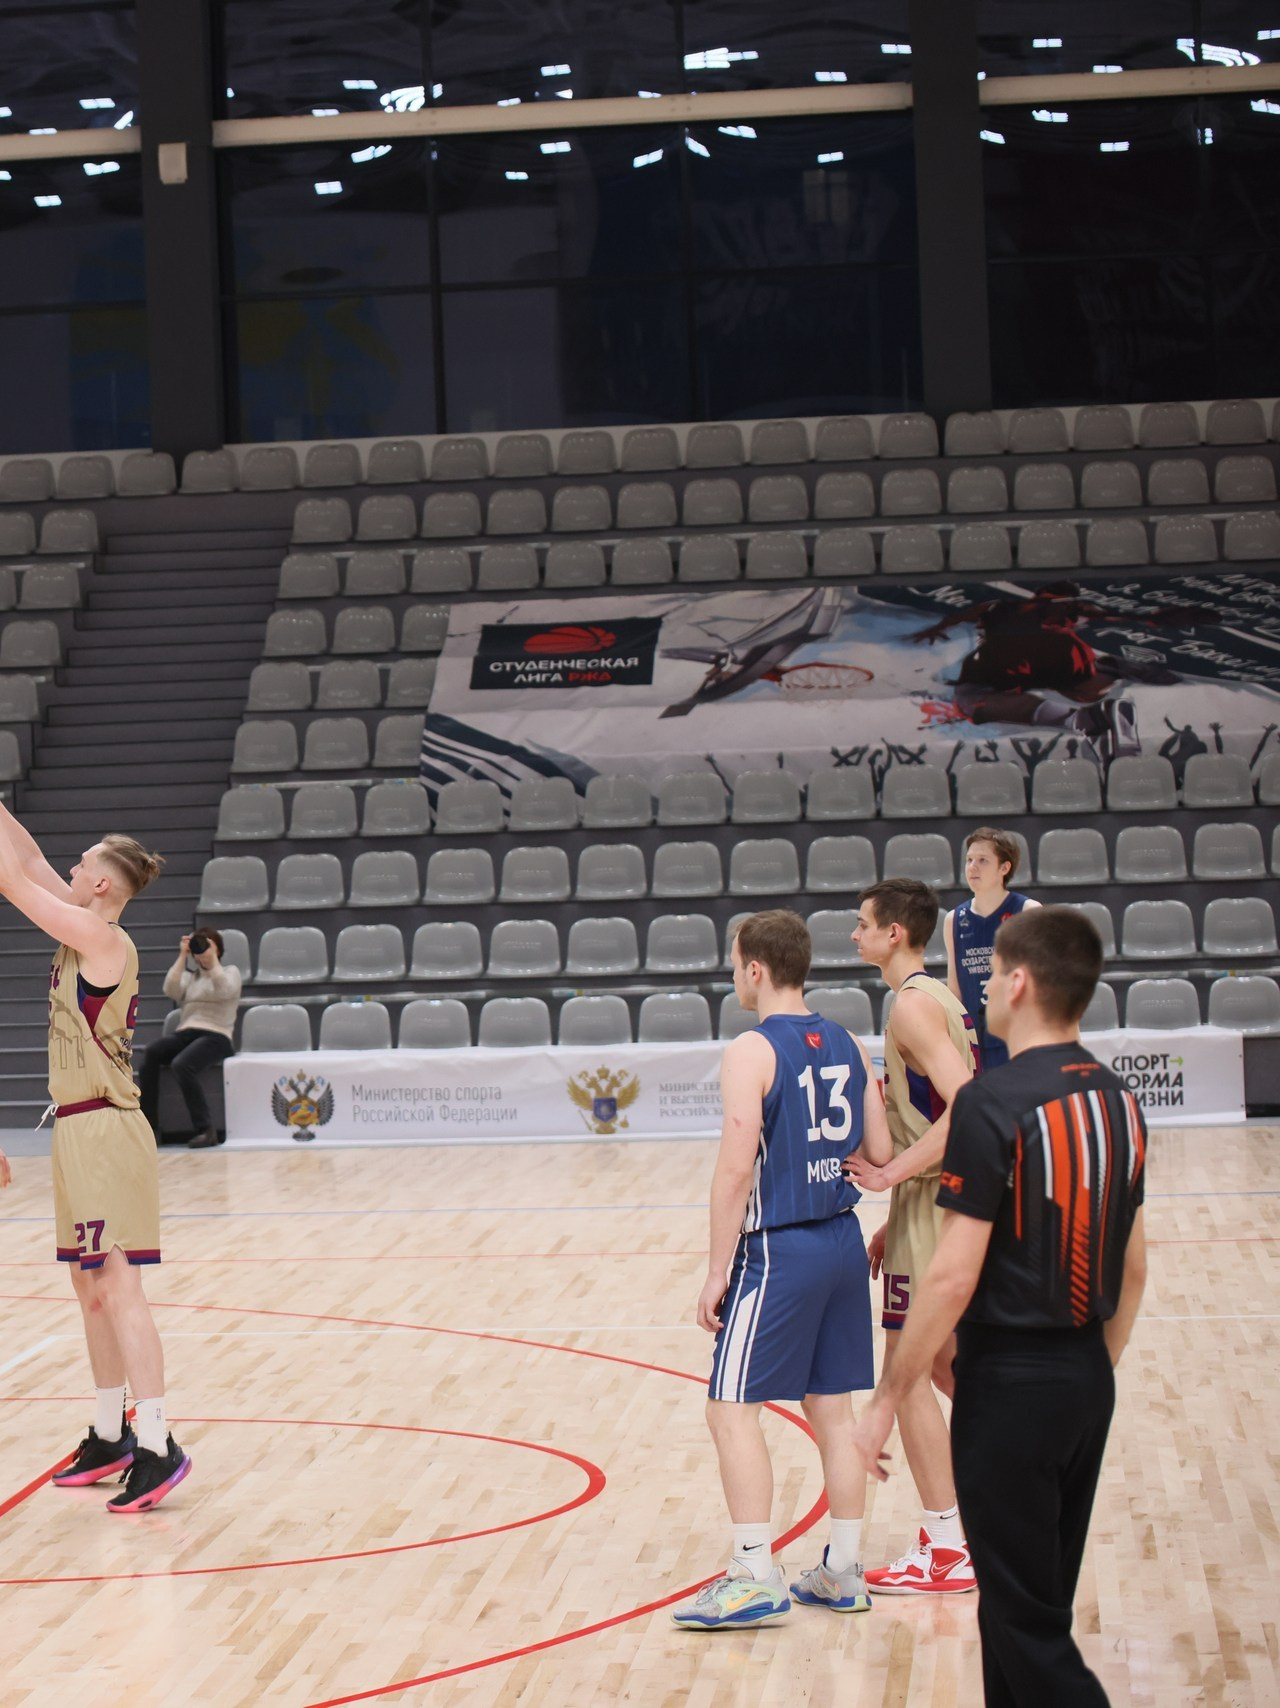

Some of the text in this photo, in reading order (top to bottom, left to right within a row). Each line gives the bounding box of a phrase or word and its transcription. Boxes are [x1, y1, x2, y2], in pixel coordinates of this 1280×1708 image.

[489, 657, 640, 672] СТУДЕНЧЕСКАЯ
[514, 672, 563, 684] ЛИГА
[1112, 1054, 1170, 1072] СПОРТ
[1121, 1071, 1184, 1090] ОРМА
[351, 1084, 503, 1105] Министерство спорта
[797, 1064, 853, 1142] 13
[1134, 1090, 1184, 1107] ИЗНИ
[352, 1104, 518, 1125] Российской Федерации
[74, 1219, 105, 1254] 27
[883, 1273, 910, 1311] 15
